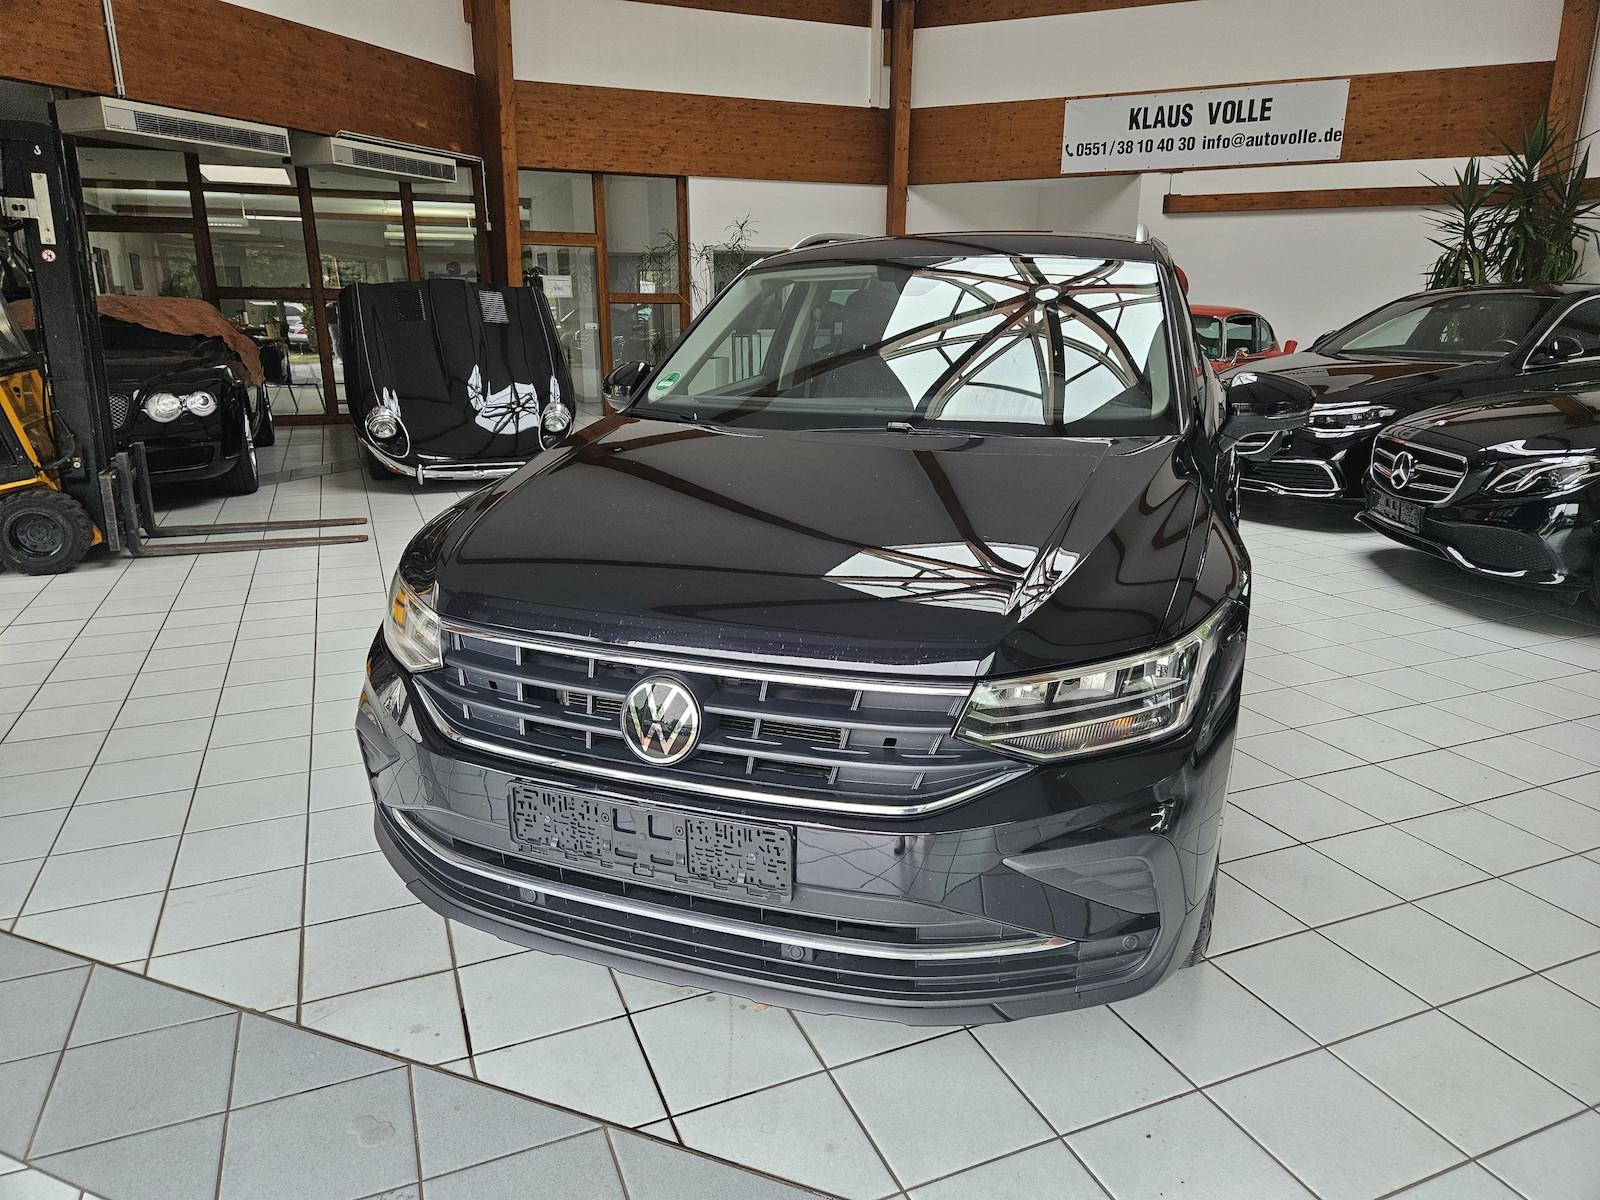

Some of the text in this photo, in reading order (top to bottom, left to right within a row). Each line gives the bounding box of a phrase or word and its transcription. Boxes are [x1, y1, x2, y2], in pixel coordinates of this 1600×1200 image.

[1128, 97, 1273, 130] KLAUS VOLLE
[1156, 138, 1174, 152] 40
[1178, 136, 1196, 151] 30
[1202, 127, 1342, 149] info@autovolle.de
[625, 680, 699, 760] VW
